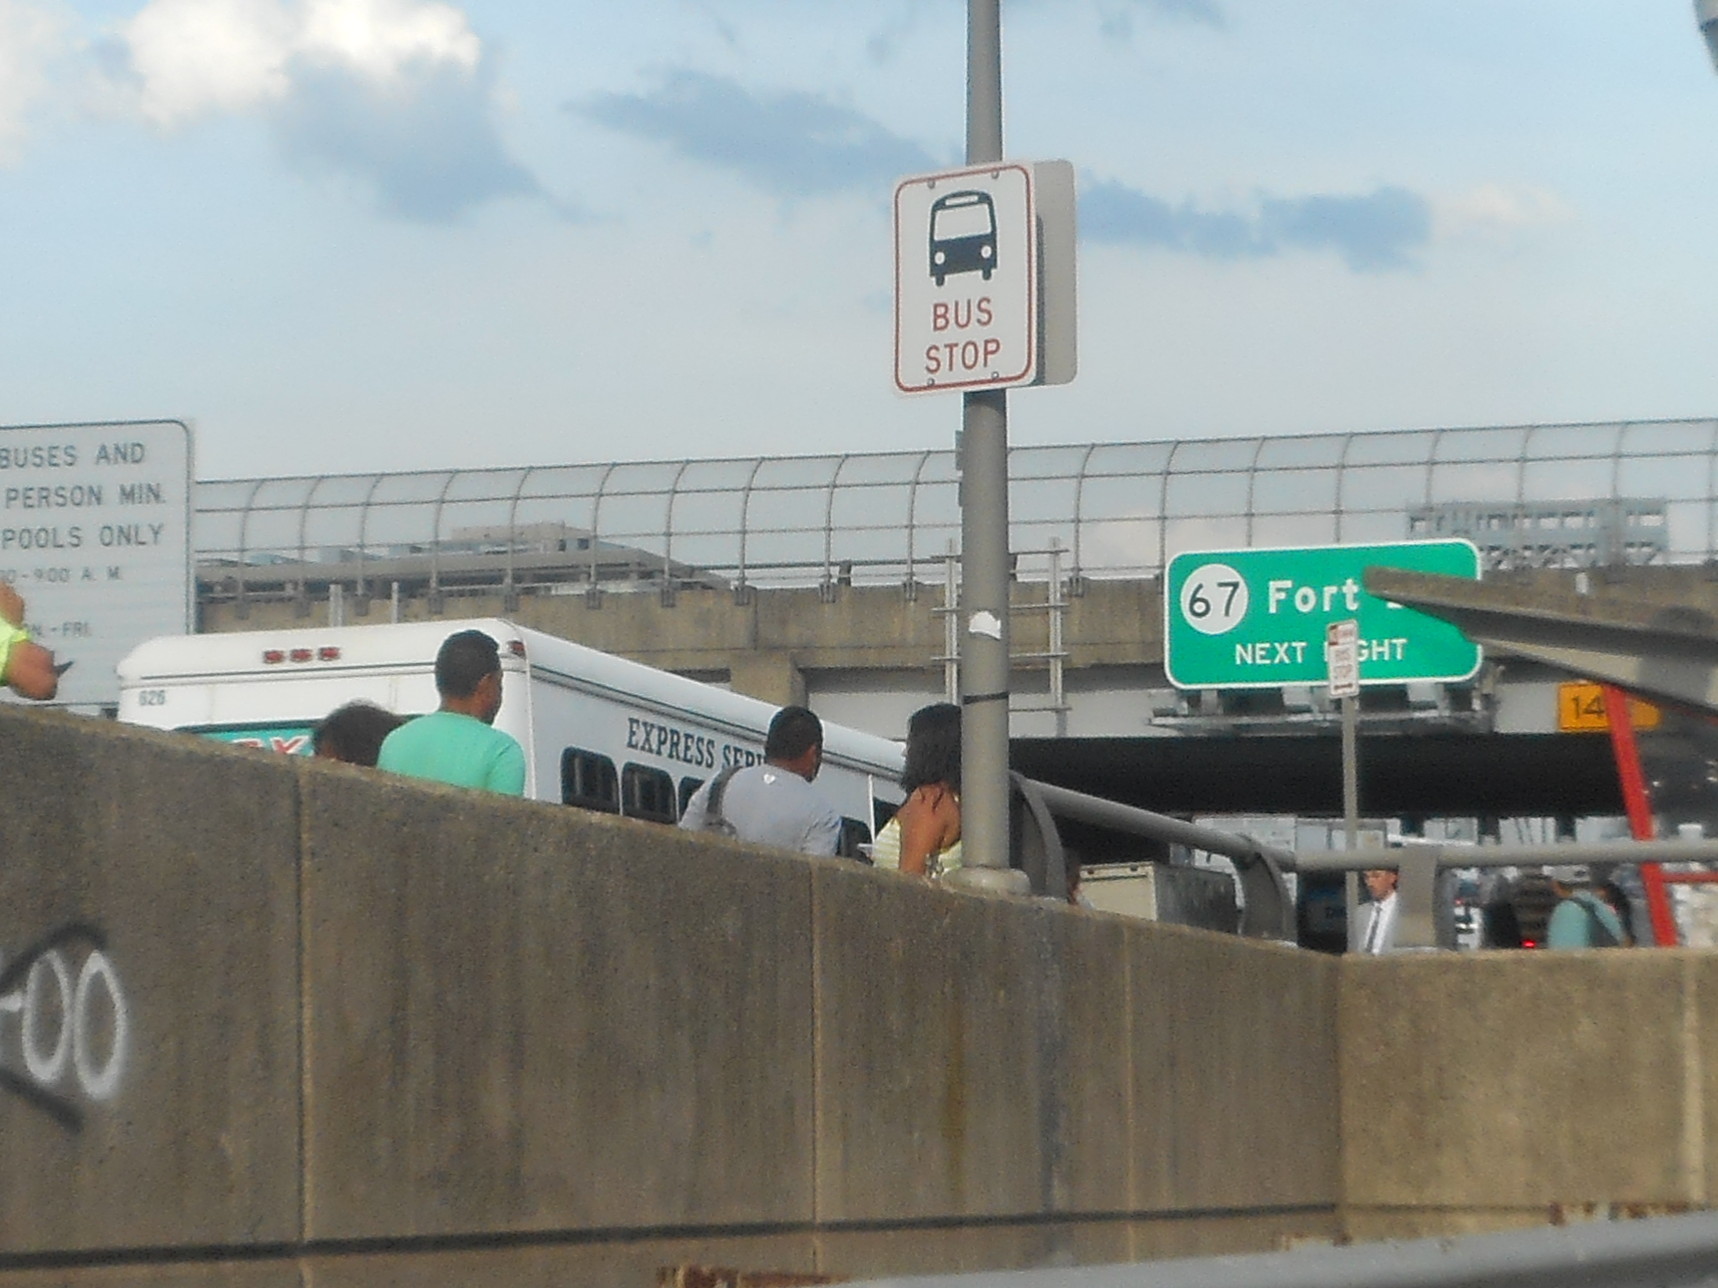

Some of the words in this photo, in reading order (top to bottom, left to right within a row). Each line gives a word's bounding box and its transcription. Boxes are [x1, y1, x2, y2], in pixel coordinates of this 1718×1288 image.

[932, 296, 994, 333] BUS
[924, 337, 1002, 375] STOP
[95, 442, 146, 466] AND
[5, 485, 103, 509] PERSON
[1, 525, 82, 550] POOLS
[98, 522, 165, 548] ONLY
[1188, 581, 1240, 619] 67
[1267, 577, 1360, 614] Fort
[1234, 641, 1308, 666] NEXT
[1323, 638, 1408, 663] GHT
[626, 717, 716, 769] EXPRESS
